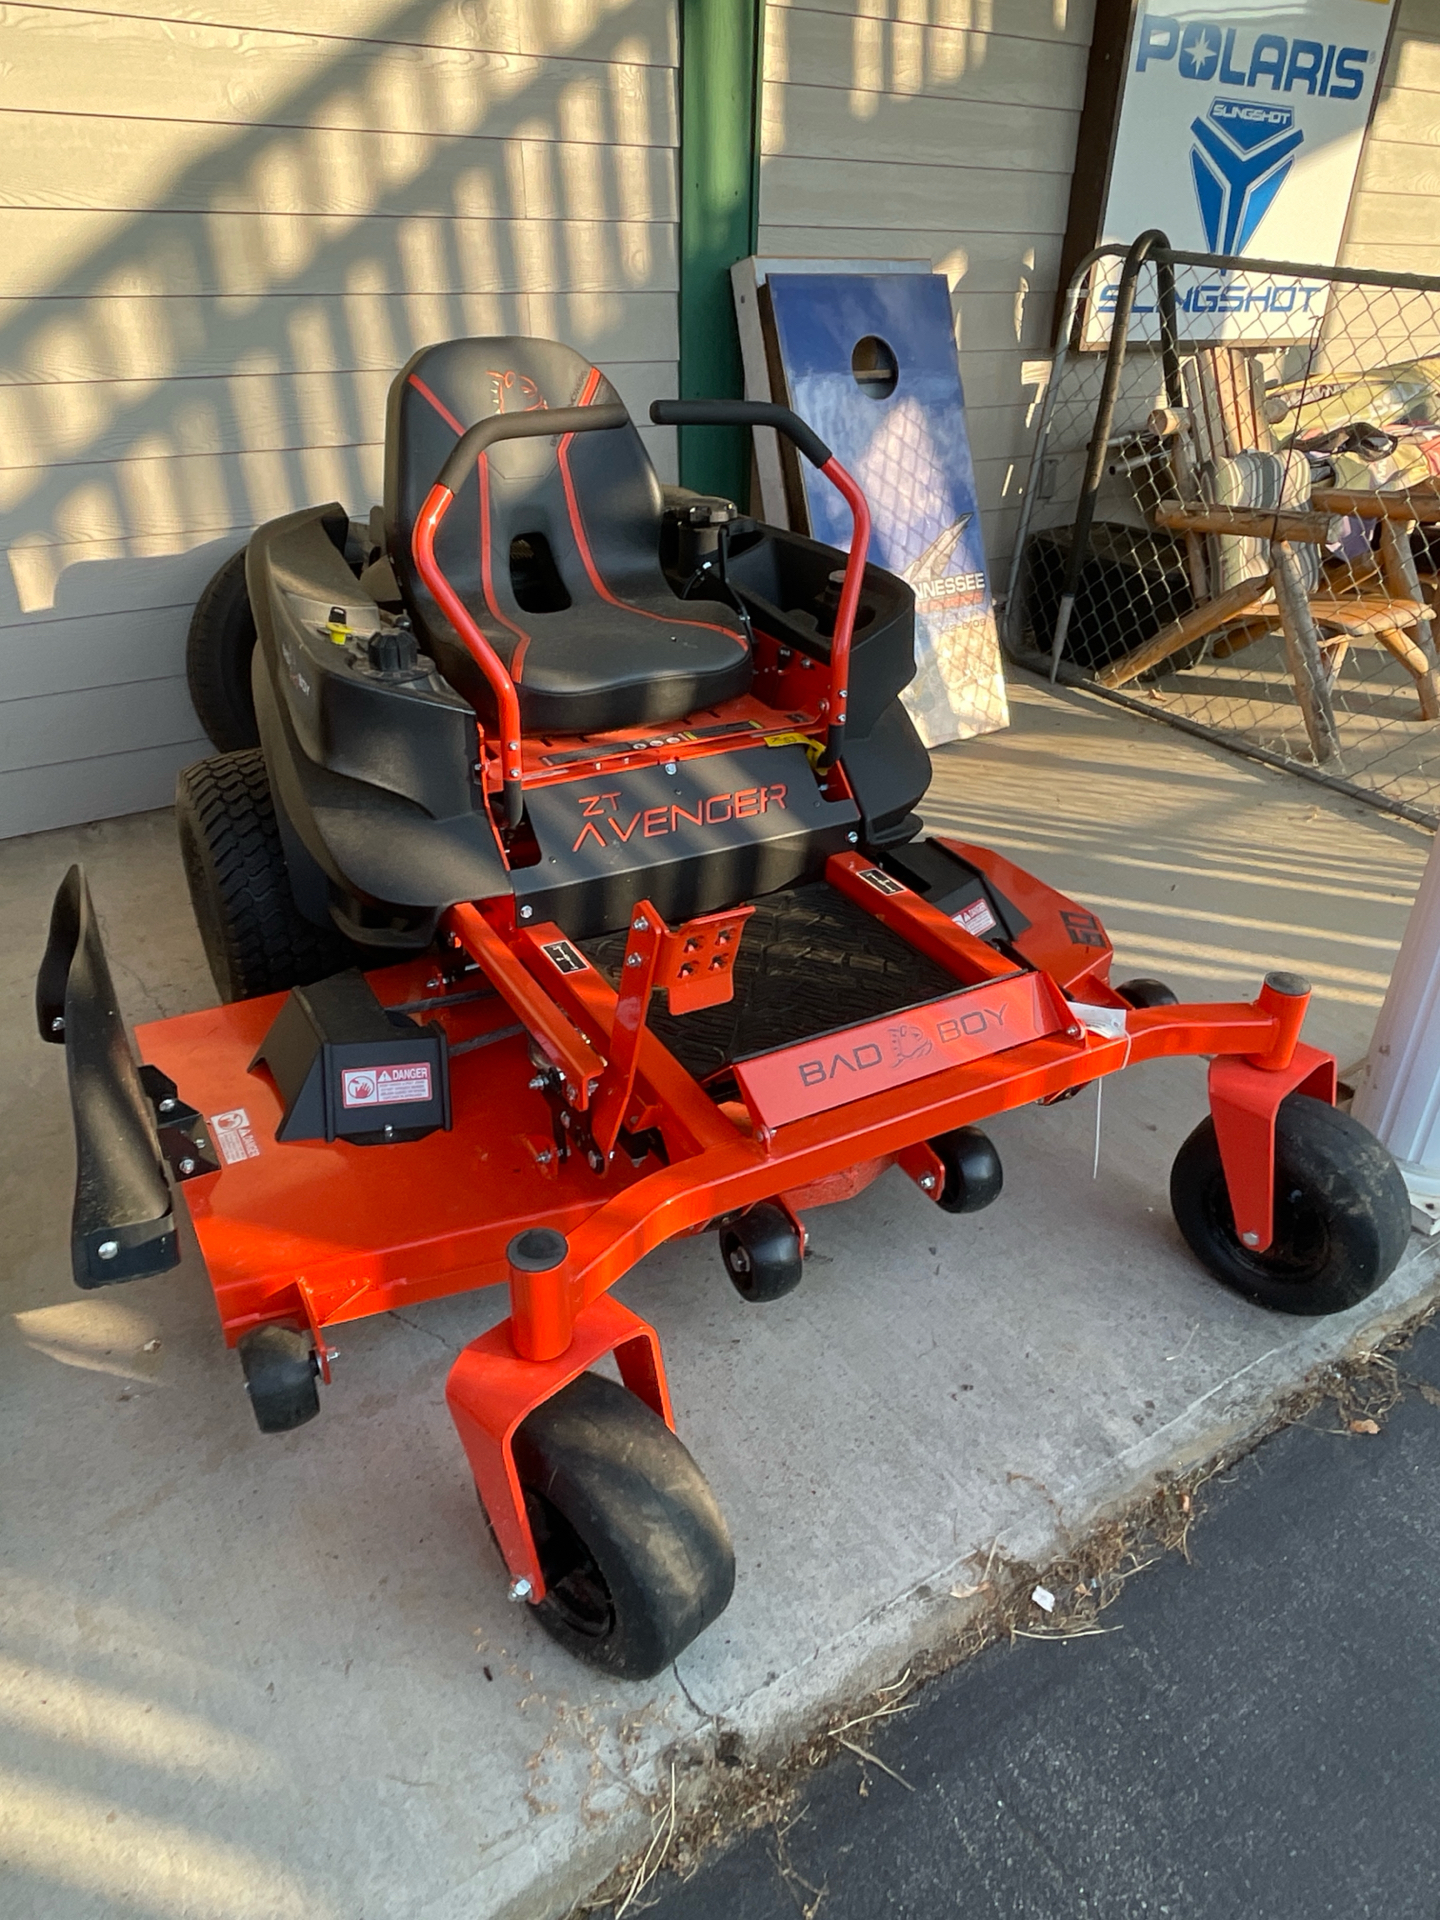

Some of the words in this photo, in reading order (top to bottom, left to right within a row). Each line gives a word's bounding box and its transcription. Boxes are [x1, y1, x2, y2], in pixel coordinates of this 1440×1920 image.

[1135, 14, 1369, 100] POLARIS
[1213, 104, 1291, 125] SLINGSHOT
[1098, 284, 1322, 313] SLNGSHOT
[911, 572, 985, 600] NNESSEE
[572, 783, 788, 852] AVENGER
[578, 792, 622, 817] ZT
[798, 1043, 884, 1087] BAD
[936, 1003, 1009, 1044] BOY
[392, 1067, 428, 1081] DANGER
